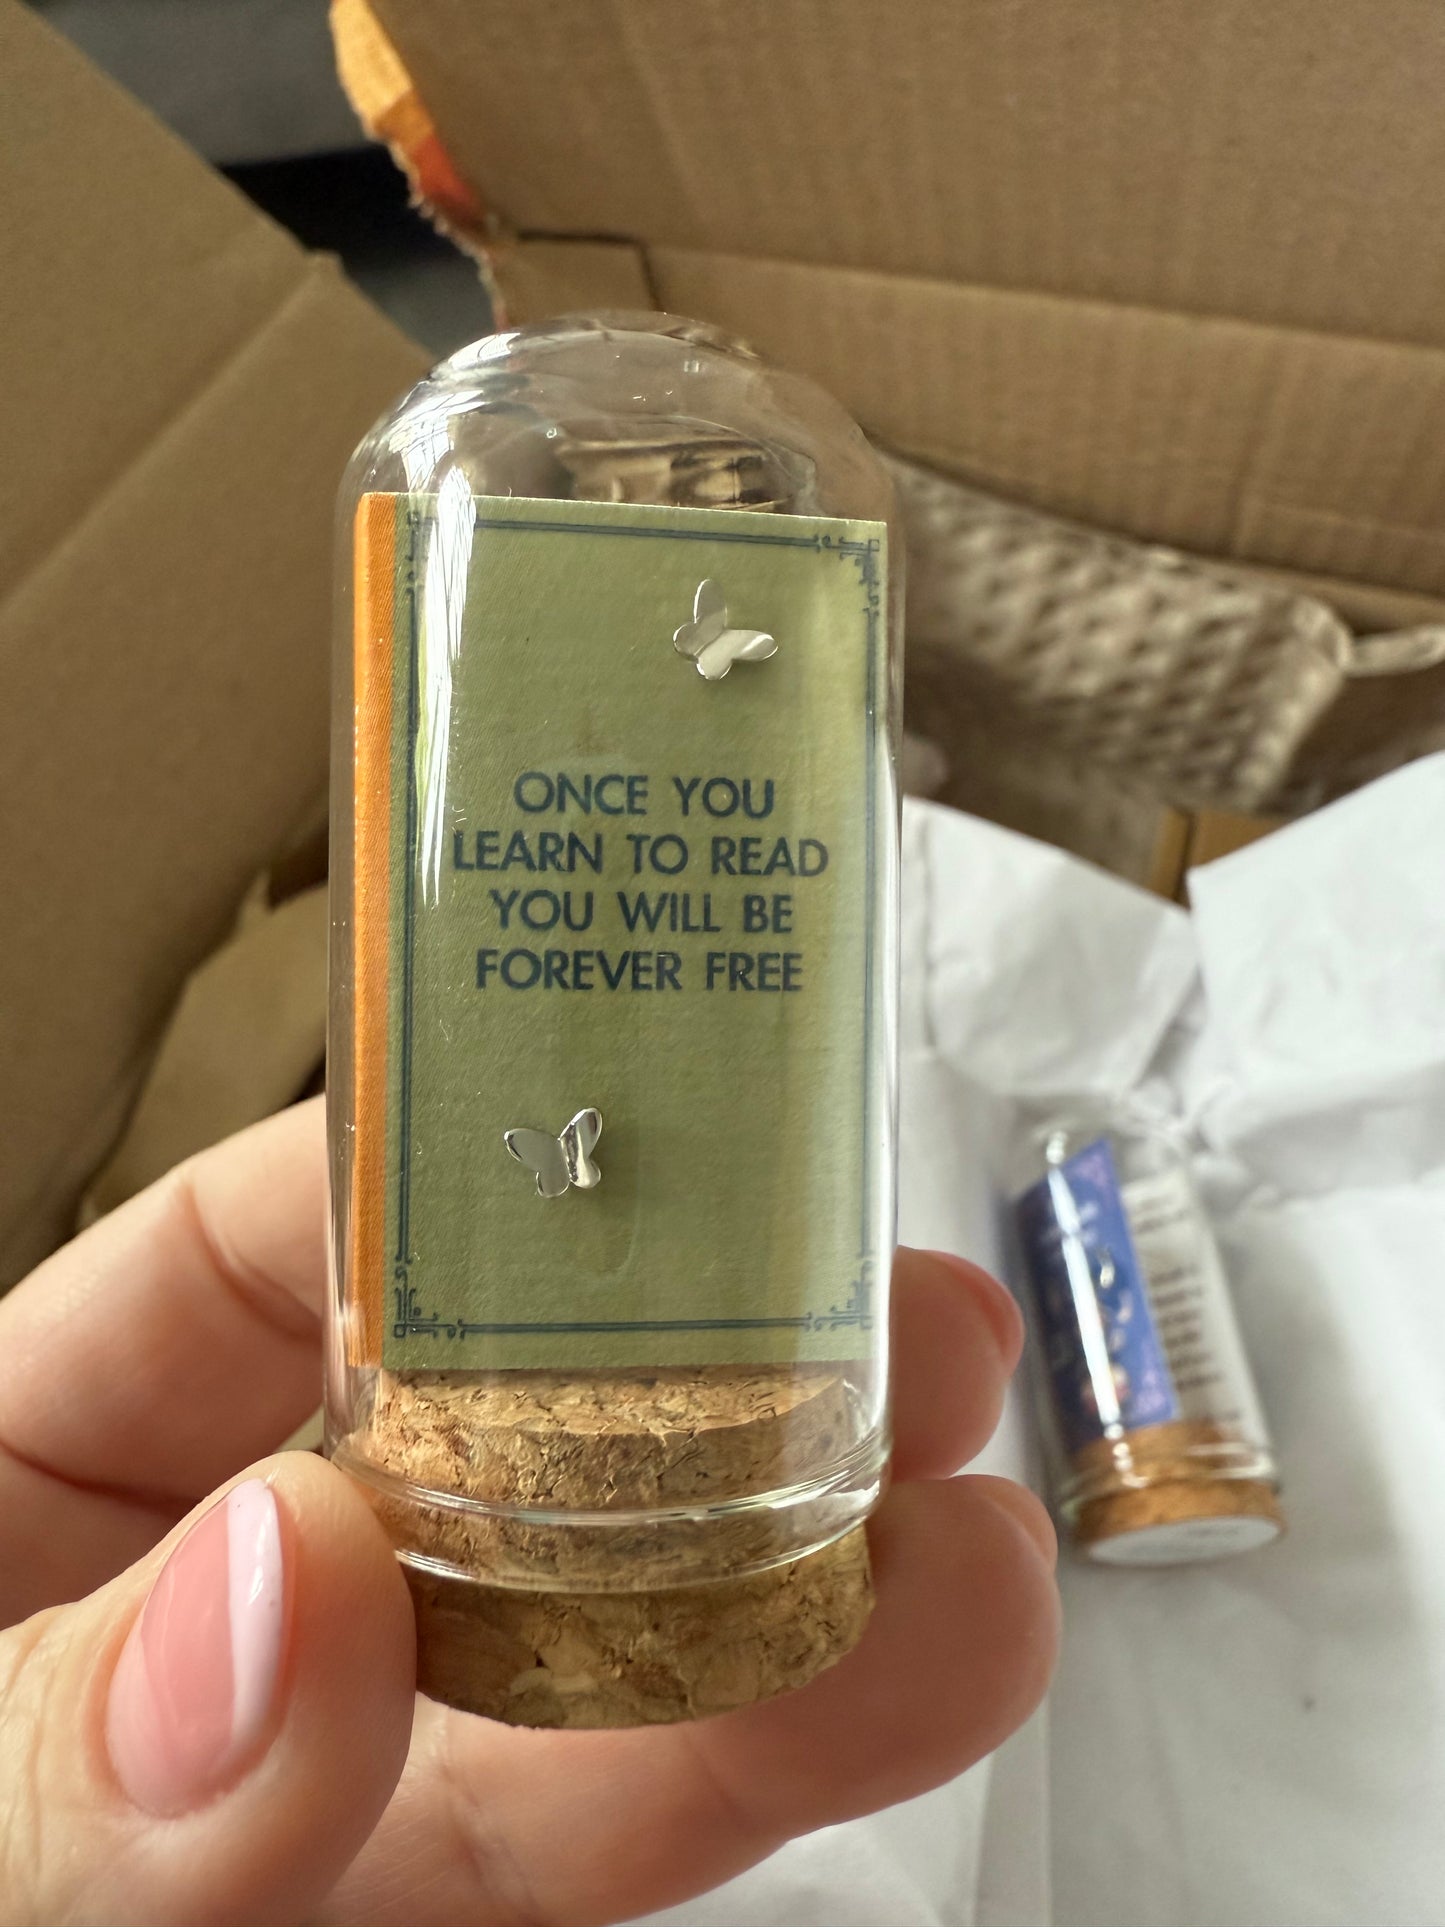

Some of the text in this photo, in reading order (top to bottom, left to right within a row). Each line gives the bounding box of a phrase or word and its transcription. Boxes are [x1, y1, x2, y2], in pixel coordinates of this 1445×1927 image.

[514, 771, 775, 819] ONCE YOU
[453, 830, 829, 877] LEARN TO READ
[489, 889, 793, 934] YOU WILL BE
[476, 948, 804, 992] FOREVER FREE
